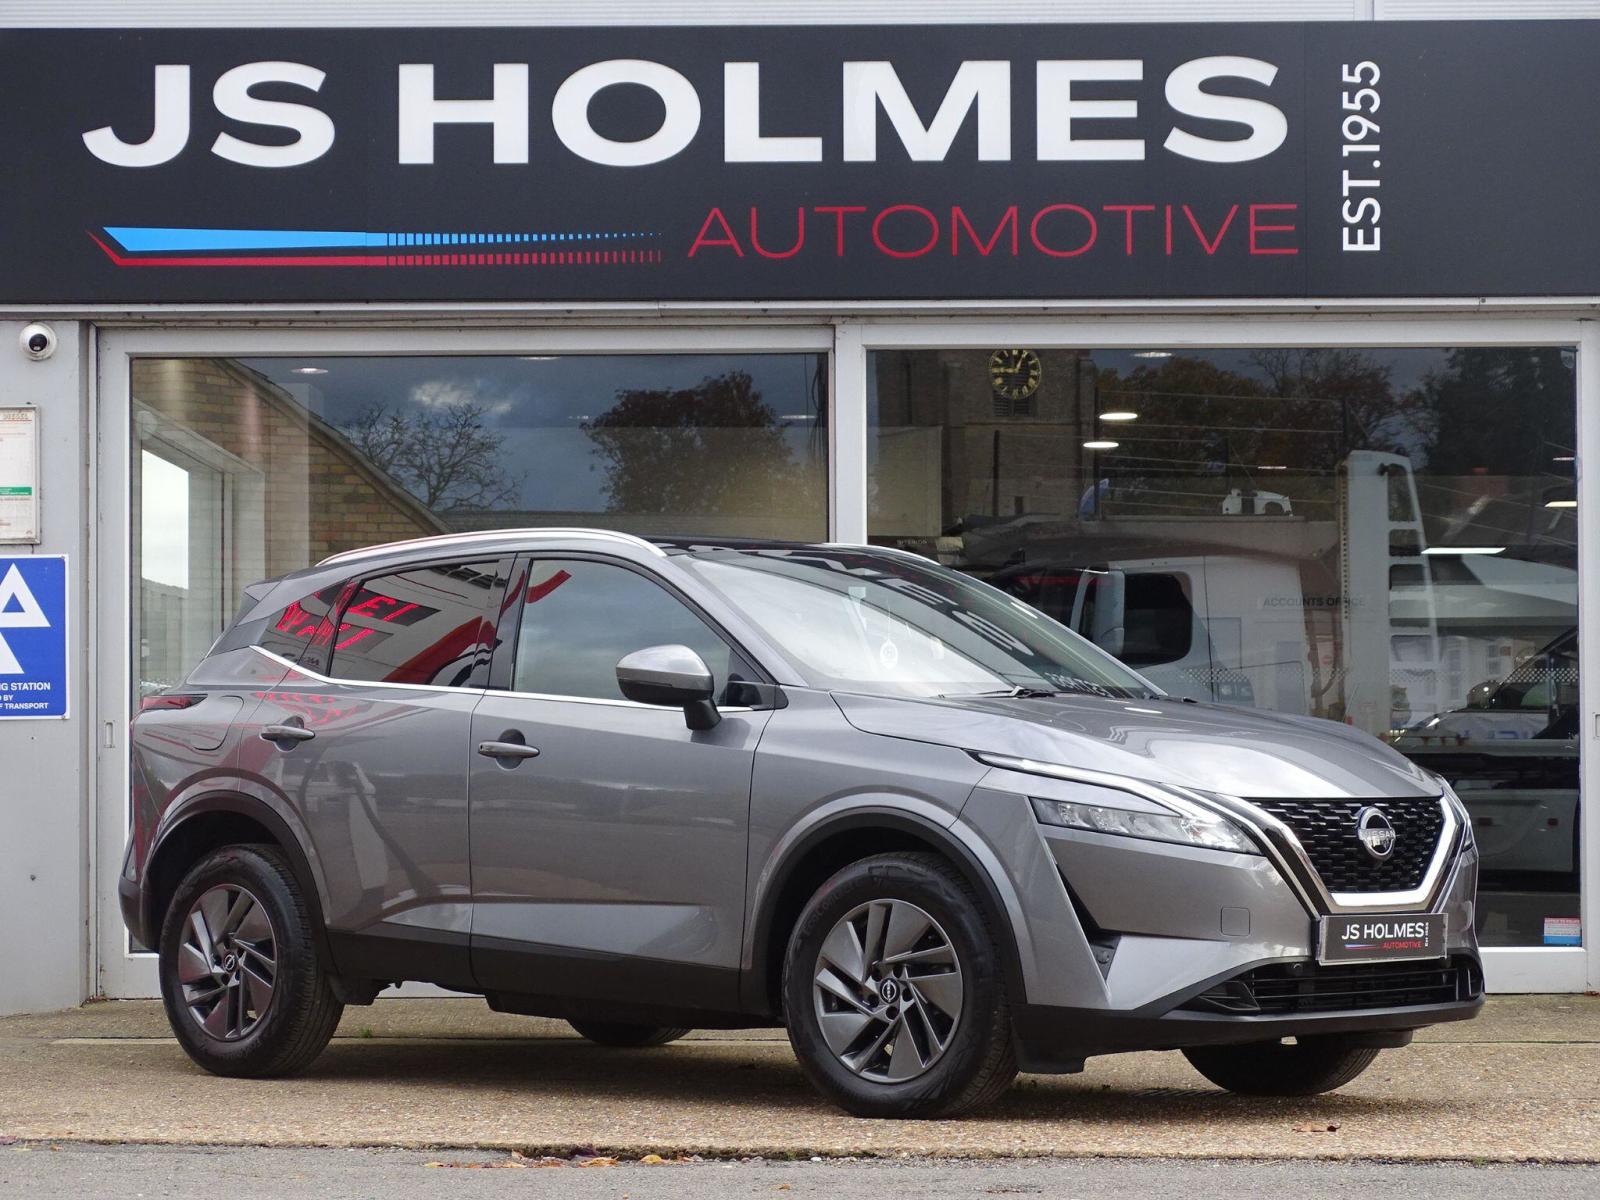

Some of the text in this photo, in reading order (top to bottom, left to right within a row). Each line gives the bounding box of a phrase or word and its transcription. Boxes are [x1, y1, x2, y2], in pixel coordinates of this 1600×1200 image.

[82, 55, 1288, 168] JS HOLMES
[1341, 60, 1382, 252] EST.1955
[687, 203, 1299, 259] AUTOMOTIVE
[10, 681, 51, 691] STATION
[3, 694, 14, 702] BY
[5, 702, 49, 710] TRANSPORT
[1341, 923, 1361, 940] JS
[1363, 922, 1425, 939] HOLMES
[1382, 941, 1422, 949] AUTOMOTIVE
